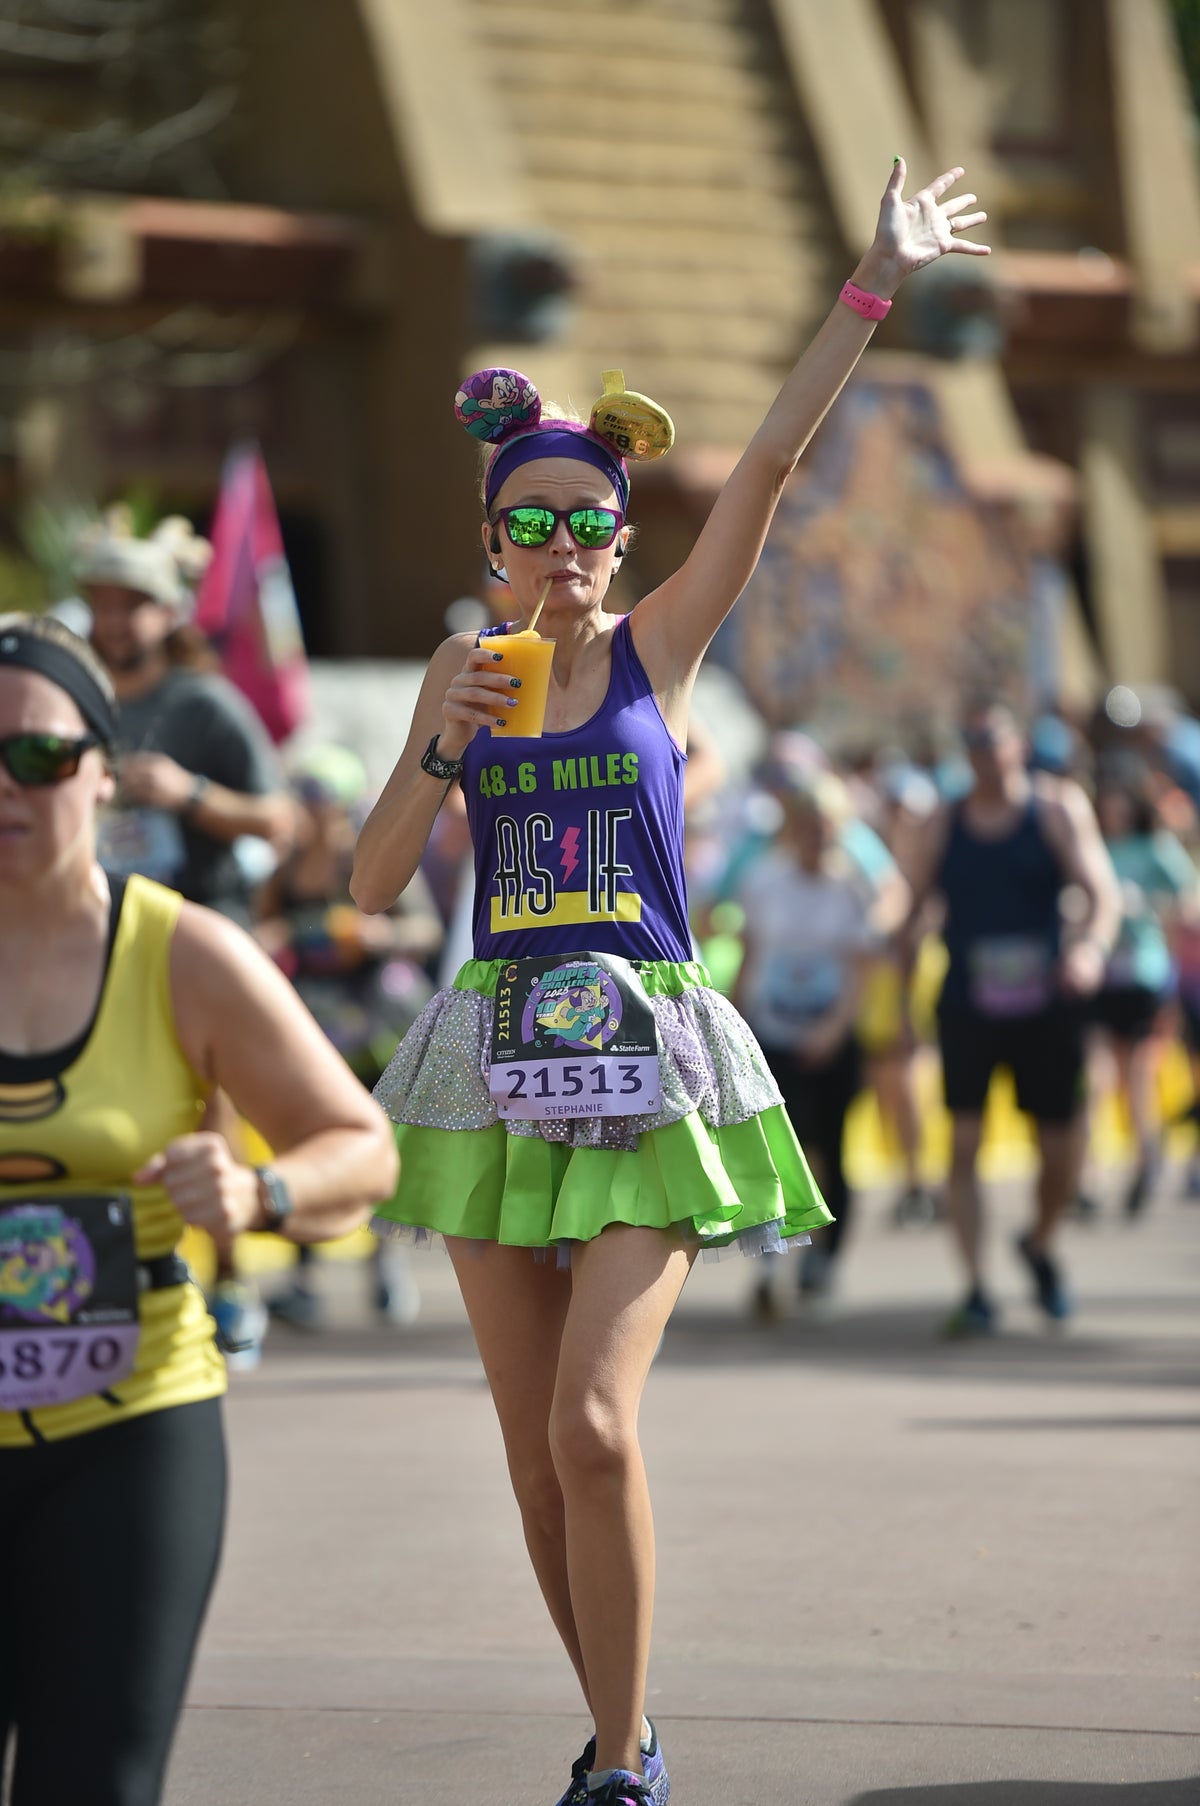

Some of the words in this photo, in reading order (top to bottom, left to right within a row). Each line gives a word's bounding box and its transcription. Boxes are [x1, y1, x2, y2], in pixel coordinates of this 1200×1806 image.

[479, 762, 537, 799] 48.6
[552, 752, 639, 791] MILES
[493, 812, 556, 918] AS
[588, 808, 633, 914] IF
[540, 978, 600, 991] CHALLENGE
[541, 966, 601, 983] DOPEY
[499, 987, 512, 1041] 21513
[536, 1001, 557, 1014] 10
[506, 1064, 642, 1099] 21513
[545, 1103, 603, 1116] STEPHANIE
